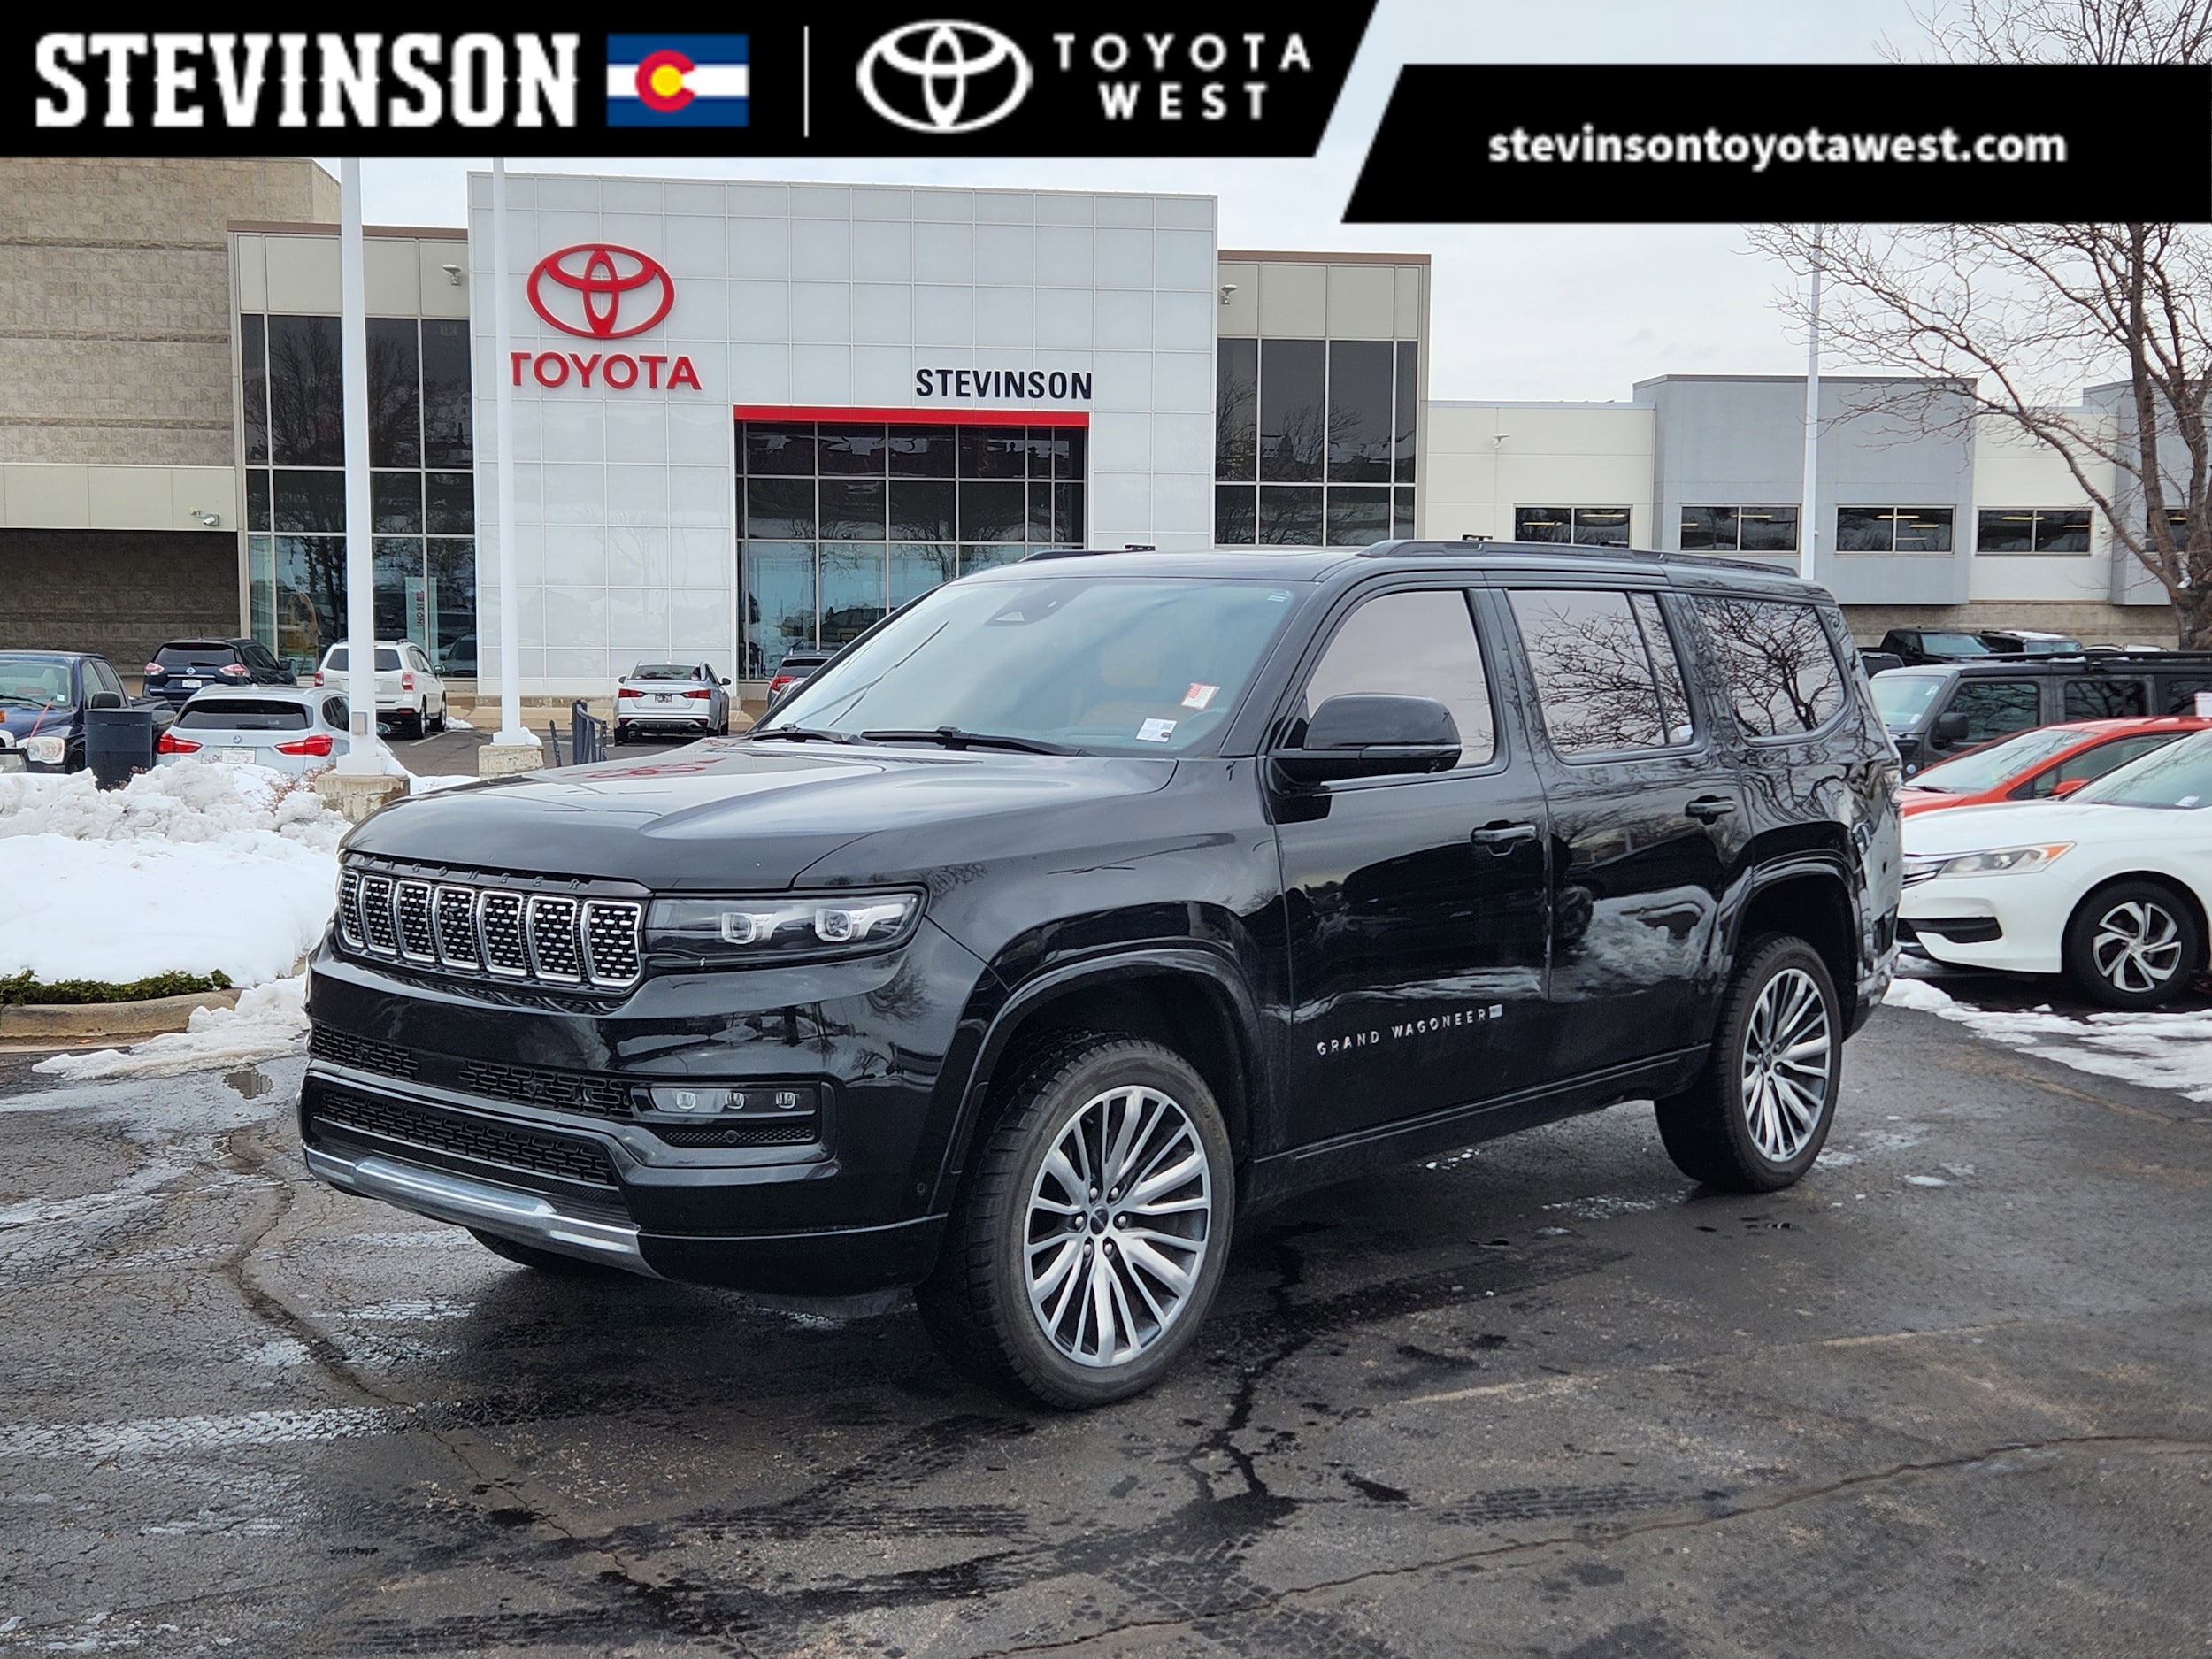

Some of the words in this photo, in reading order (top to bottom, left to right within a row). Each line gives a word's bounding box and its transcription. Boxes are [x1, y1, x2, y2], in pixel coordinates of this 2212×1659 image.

[510, 351, 703, 390] TOYOTA
[916, 368, 1092, 400] STEVINSON
[1317, 1031, 1379, 1056] GRAND
[1391, 1008, 1486, 1039] WAGONEER
